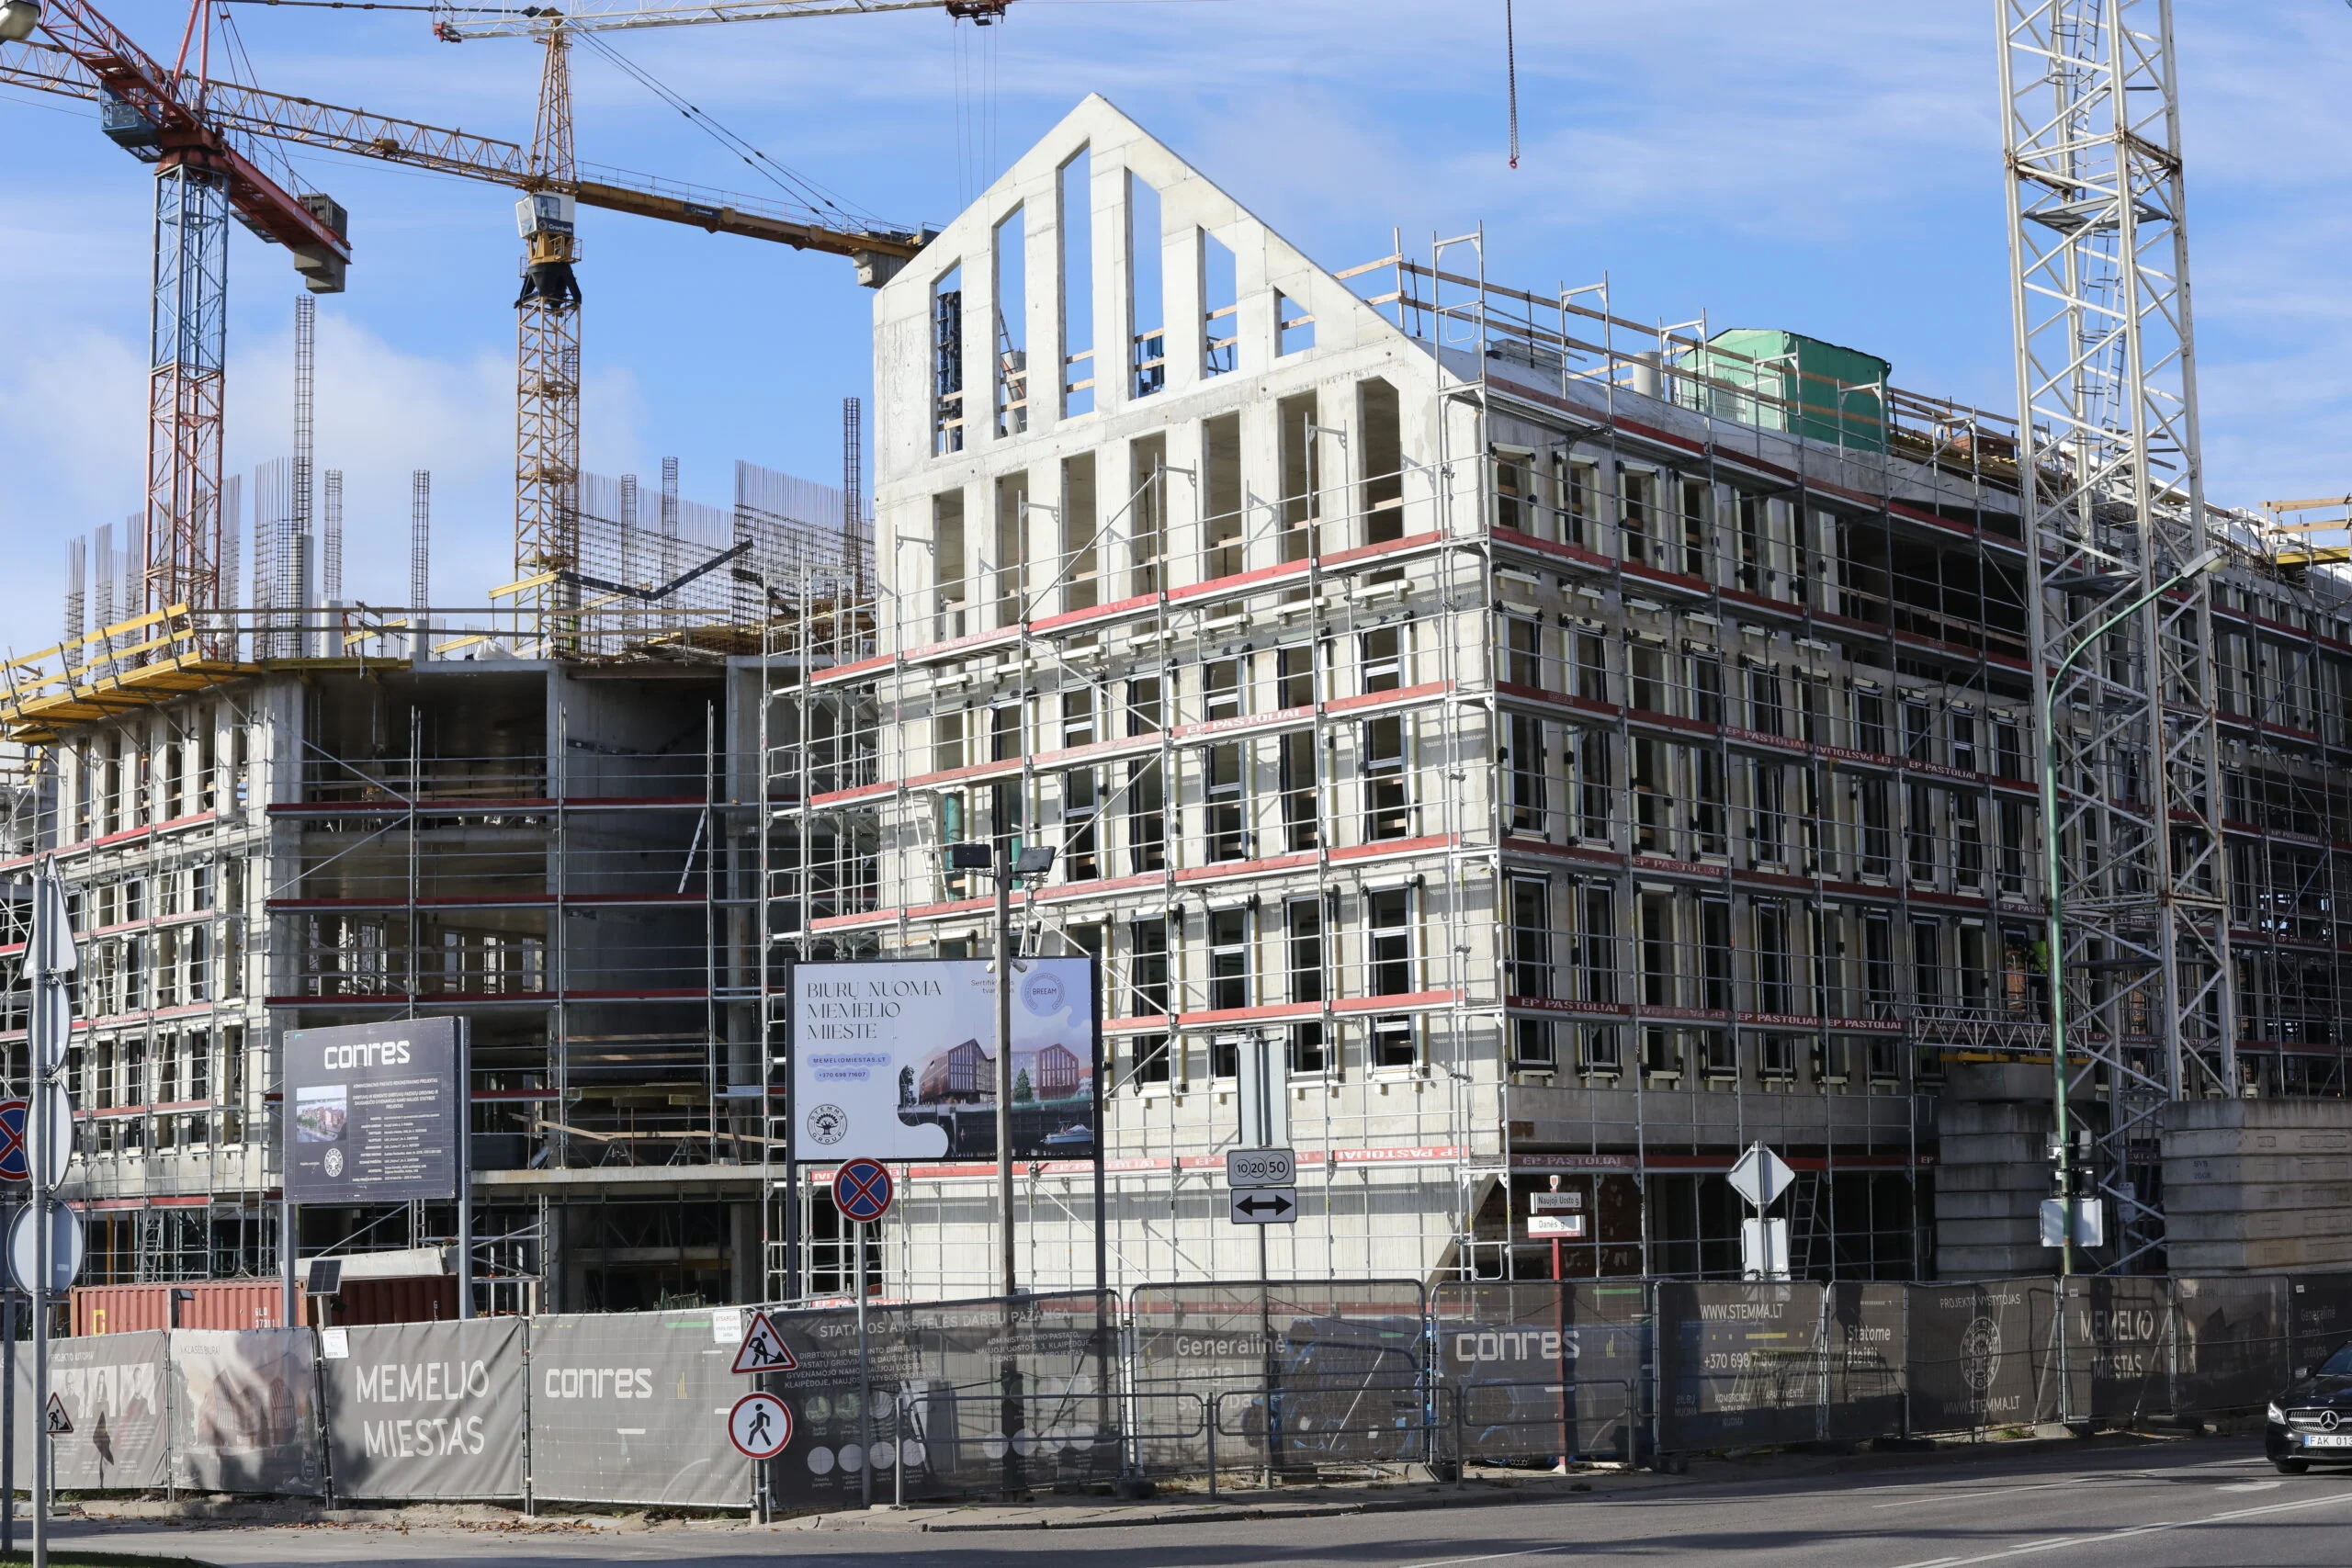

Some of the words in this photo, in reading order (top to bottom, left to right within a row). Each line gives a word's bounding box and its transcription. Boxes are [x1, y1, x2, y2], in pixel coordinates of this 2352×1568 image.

[1186, 722, 1206, 733] EP
[1212, 708, 1300, 729] PASTOLIAI
[1725, 728, 1741, 736] EP
[1744, 729, 1806, 751] PASTOLIAI
[1908, 760, 1922, 769] EP
[1925, 763, 1976, 780] PASTOLIAI
[1632, 857, 1648, 866] EP
[808, 981, 860, 1000] BIURŲ
[868, 980, 942, 998] NUOMA
[1032, 987, 1057, 996] BREEAM
[808, 1001, 900, 1019] MEMELIO
[1521, 998, 1540, 1008] EP
[1544, 998, 1619, 1013] PASTOLIAI
[1737, 1013, 1752, 1021] EP
[1757, 1014, 1818, 1026] PASTOLIAI
[1828, 1019, 1841, 1027] EP
[1845, 1020, 1902, 1031] PASTOLIAI
[808, 1022, 877, 1040] MIESTE
[324, 1040, 411, 1070] conres
[810, 1106, 844, 1121] STEMMA
[812, 1132, 842, 1144] GROUP
[1195, 1156, 1216, 1166] EP
[1339, 1149, 1433, 1160] PASTOLIAI
[1522, 1156, 1541, 1165] EP
[1547, 1156, 1622, 1165] PASTOLIAI
[1921, 1156, 1934, 1164] EP
[1237, 1164, 1248, 1173] 10
[1250, 1163, 1265, 1173] 20
[1269, 1162, 1286, 1173] 50
[1538, 1196, 1557, 1206] Naujoji
[1559, 1196, 1574, 1204] Uosto
[1538, 1220, 1558, 1228] Danės
[1939, 1295, 1977, 1309] PROJEKTO
[1977, 1293, 2021, 1306] VYSTYTOJAS
[1700, 1303, 1783, 1320] WWW.STEMMA.LT
[820, 1322, 886, 1337] STATYOS
[1011, 1307, 1070, 1324] PAŽANGA
[2080, 1310, 2154, 1342] MEMELIO
[987, 1334, 1047, 1346] ADMINISTRACINIO
[1848, 1325, 1891, 1341] Statome
[1006, 1345, 1031, 1353] UOSTO
[1176, 1334, 1285, 1357] Generalinė
[1456, 1331, 1580, 1361] conres
[799, 1351, 837, 1360] DIRBTUVIŲ
[1704, 1353, 1727, 1369] +370
[1730, 1352, 1750, 1368] 698
[798, 1360, 828, 1369] PASTATŲ
[831, 1359, 861, 1367] GRIOVIM
[2094, 1354, 2143, 1379] MIESTAS
[356, 1359, 490, 1404] MEMELIO
[785, 1380, 831, 1389] KLAIPĖDOJE,
[832, 1378, 861, 1386] NAUJOS
[867, 1374, 899, 1382] TATYBOS
[786, 1370, 837, 1379] GYVENAMOJO
[545, 1368, 653, 1399] conres
[1943, 1395, 2020, 1415] WWW.STEMMA.LT
[364, 1415, 485, 1458] MIESTAS
[2310, 1436, 2330, 1446] FAK
